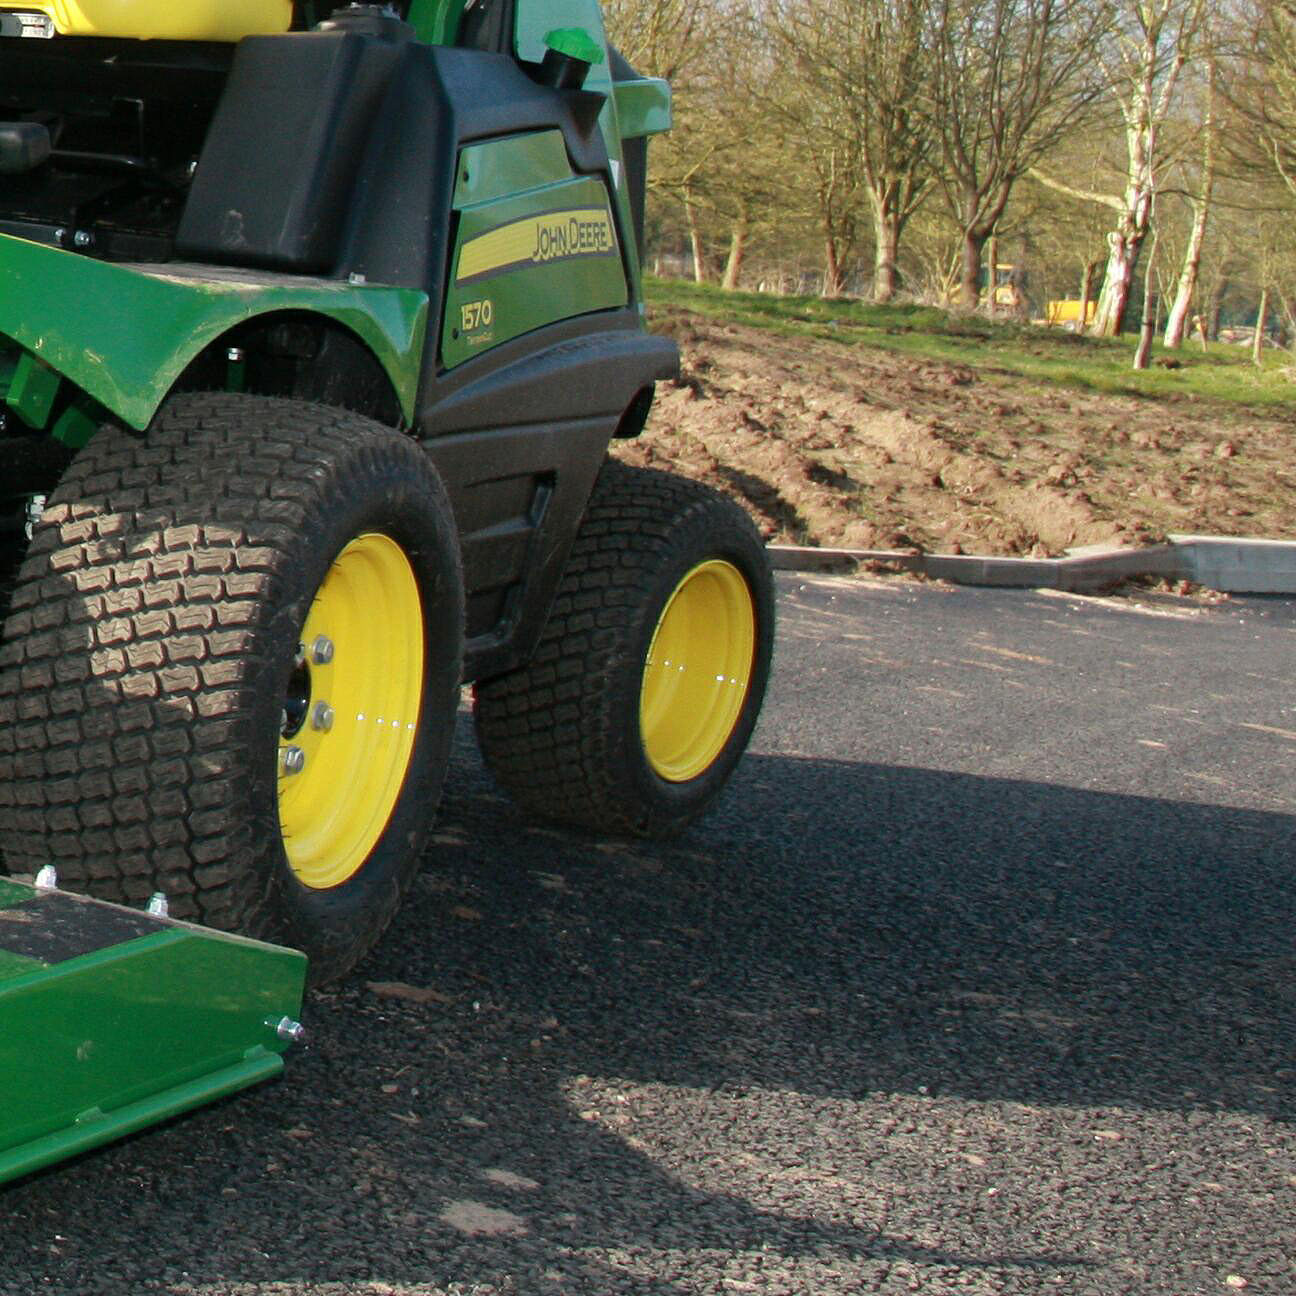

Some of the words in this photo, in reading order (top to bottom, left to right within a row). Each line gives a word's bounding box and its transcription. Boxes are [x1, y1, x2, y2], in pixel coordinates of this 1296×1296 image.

[532, 222, 568, 257] JOHN
[568, 217, 608, 251] DEERE
[461, 299, 492, 331] 1570
